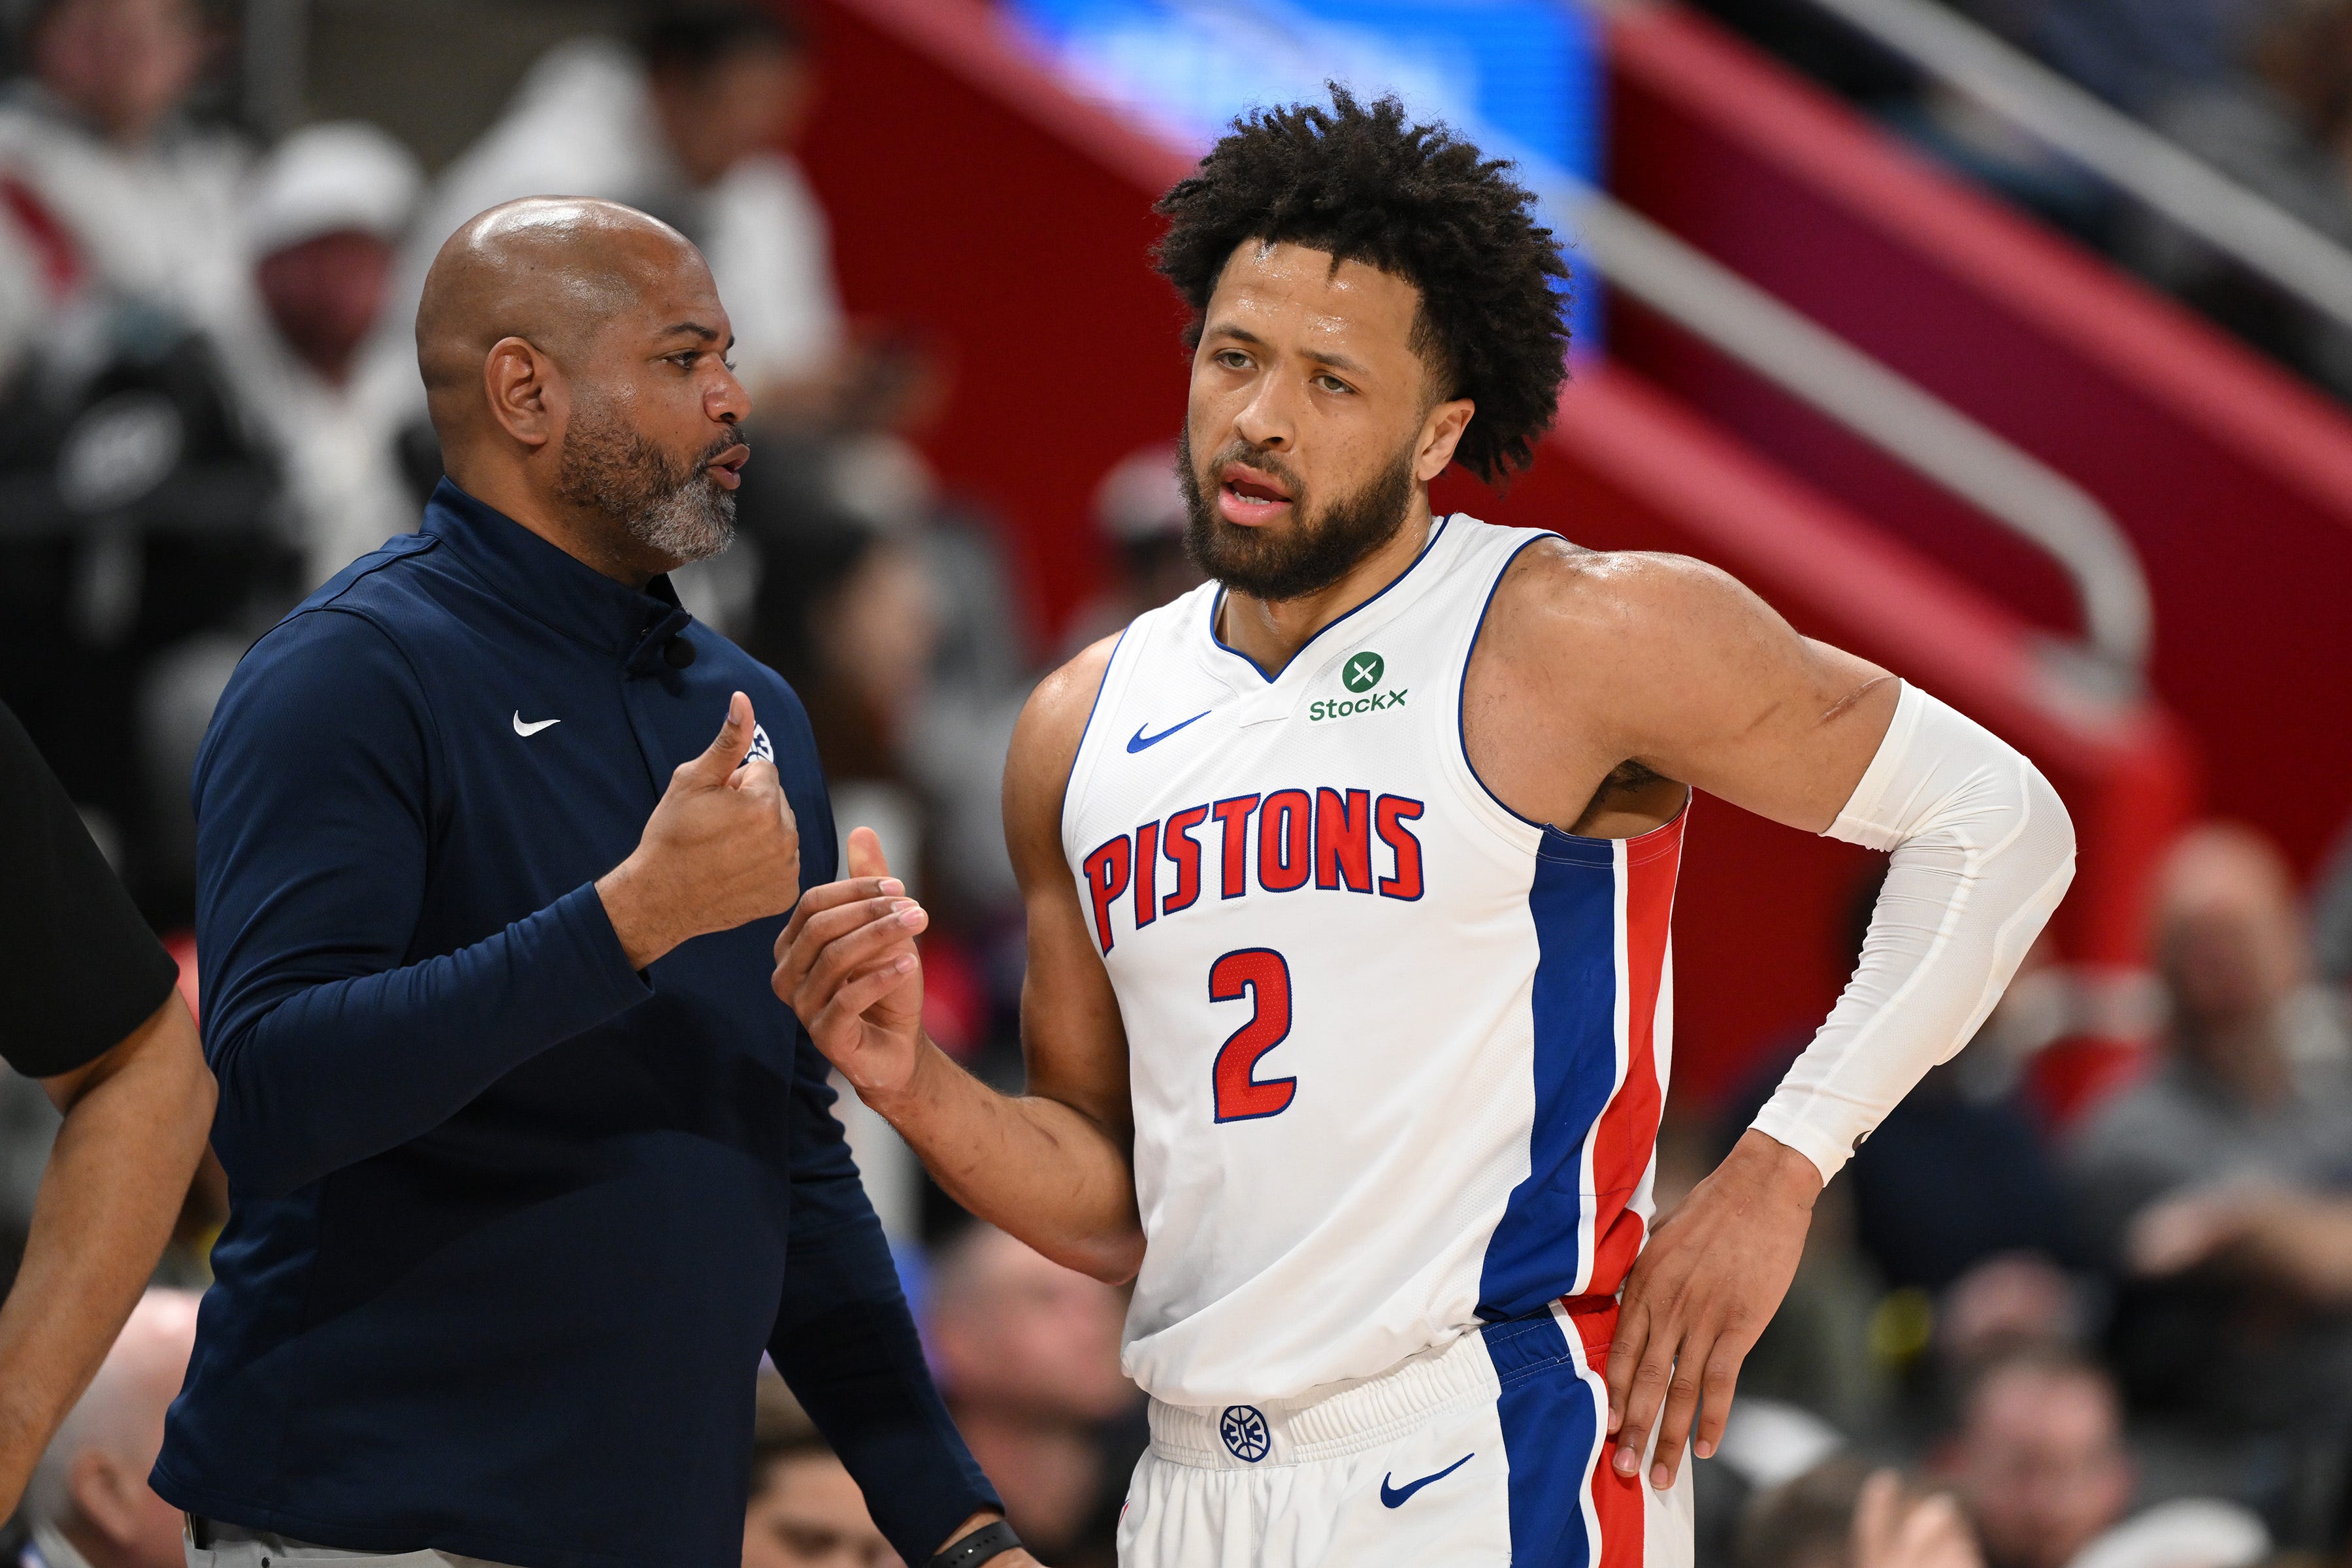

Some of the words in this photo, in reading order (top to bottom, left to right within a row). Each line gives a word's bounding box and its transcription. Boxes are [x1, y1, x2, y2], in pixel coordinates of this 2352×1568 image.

[1309, 688, 1409, 721] StockX
[1083, 786, 1425, 958] PISTONS
[1208, 947, 1297, 1124] 2
